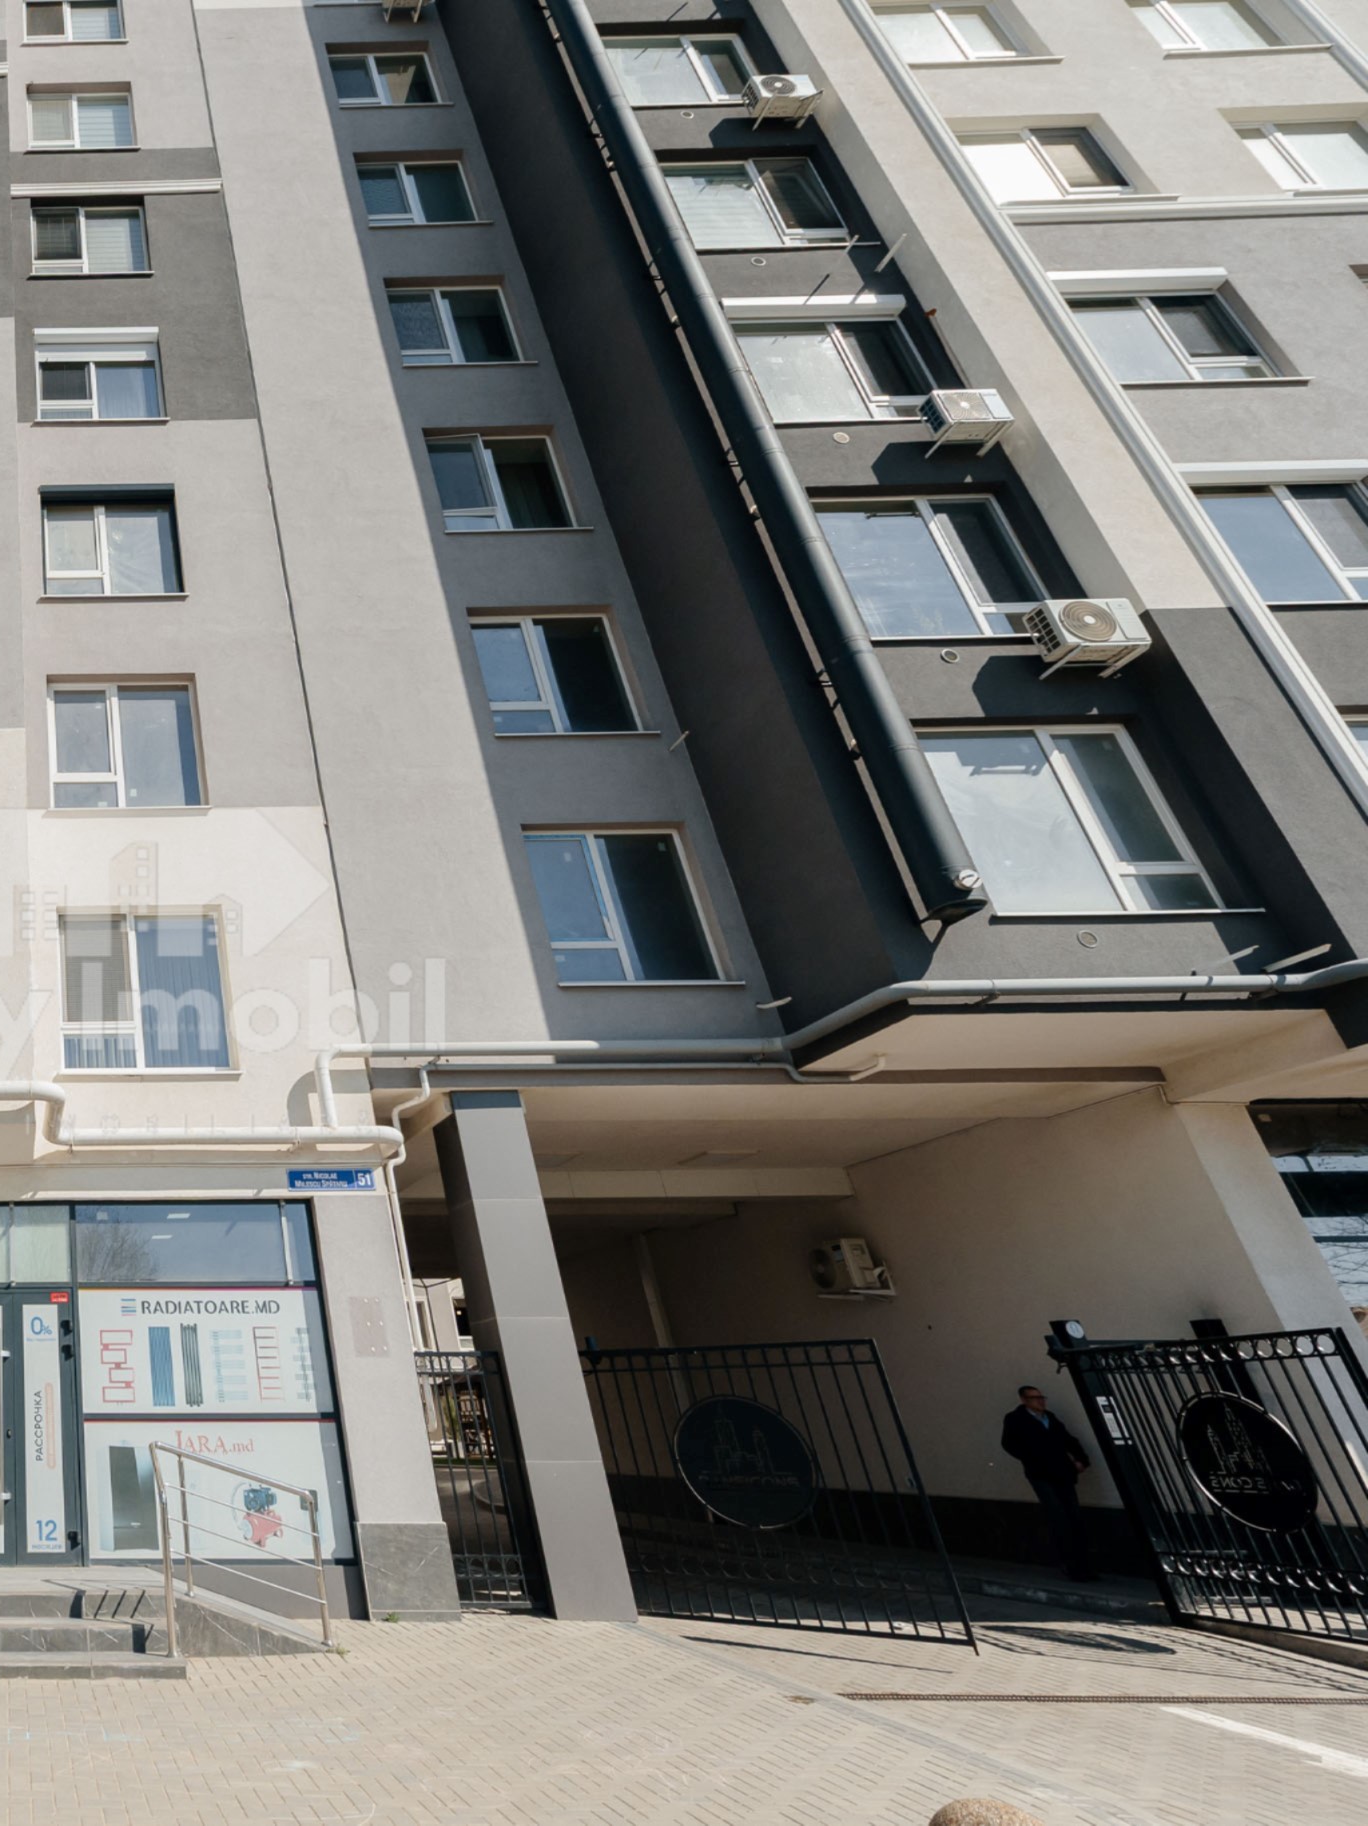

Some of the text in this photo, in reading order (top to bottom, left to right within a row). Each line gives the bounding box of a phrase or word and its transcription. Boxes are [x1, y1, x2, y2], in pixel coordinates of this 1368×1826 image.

[357, 1173, 371, 1186] 51
[141, 1300, 280, 1314] RADIATOARE.MD
[31, 1317, 53, 1335] 0%
[34, 1390, 43, 1461] РАССРОЧКА
[36, 1520, 58, 1541] 12
